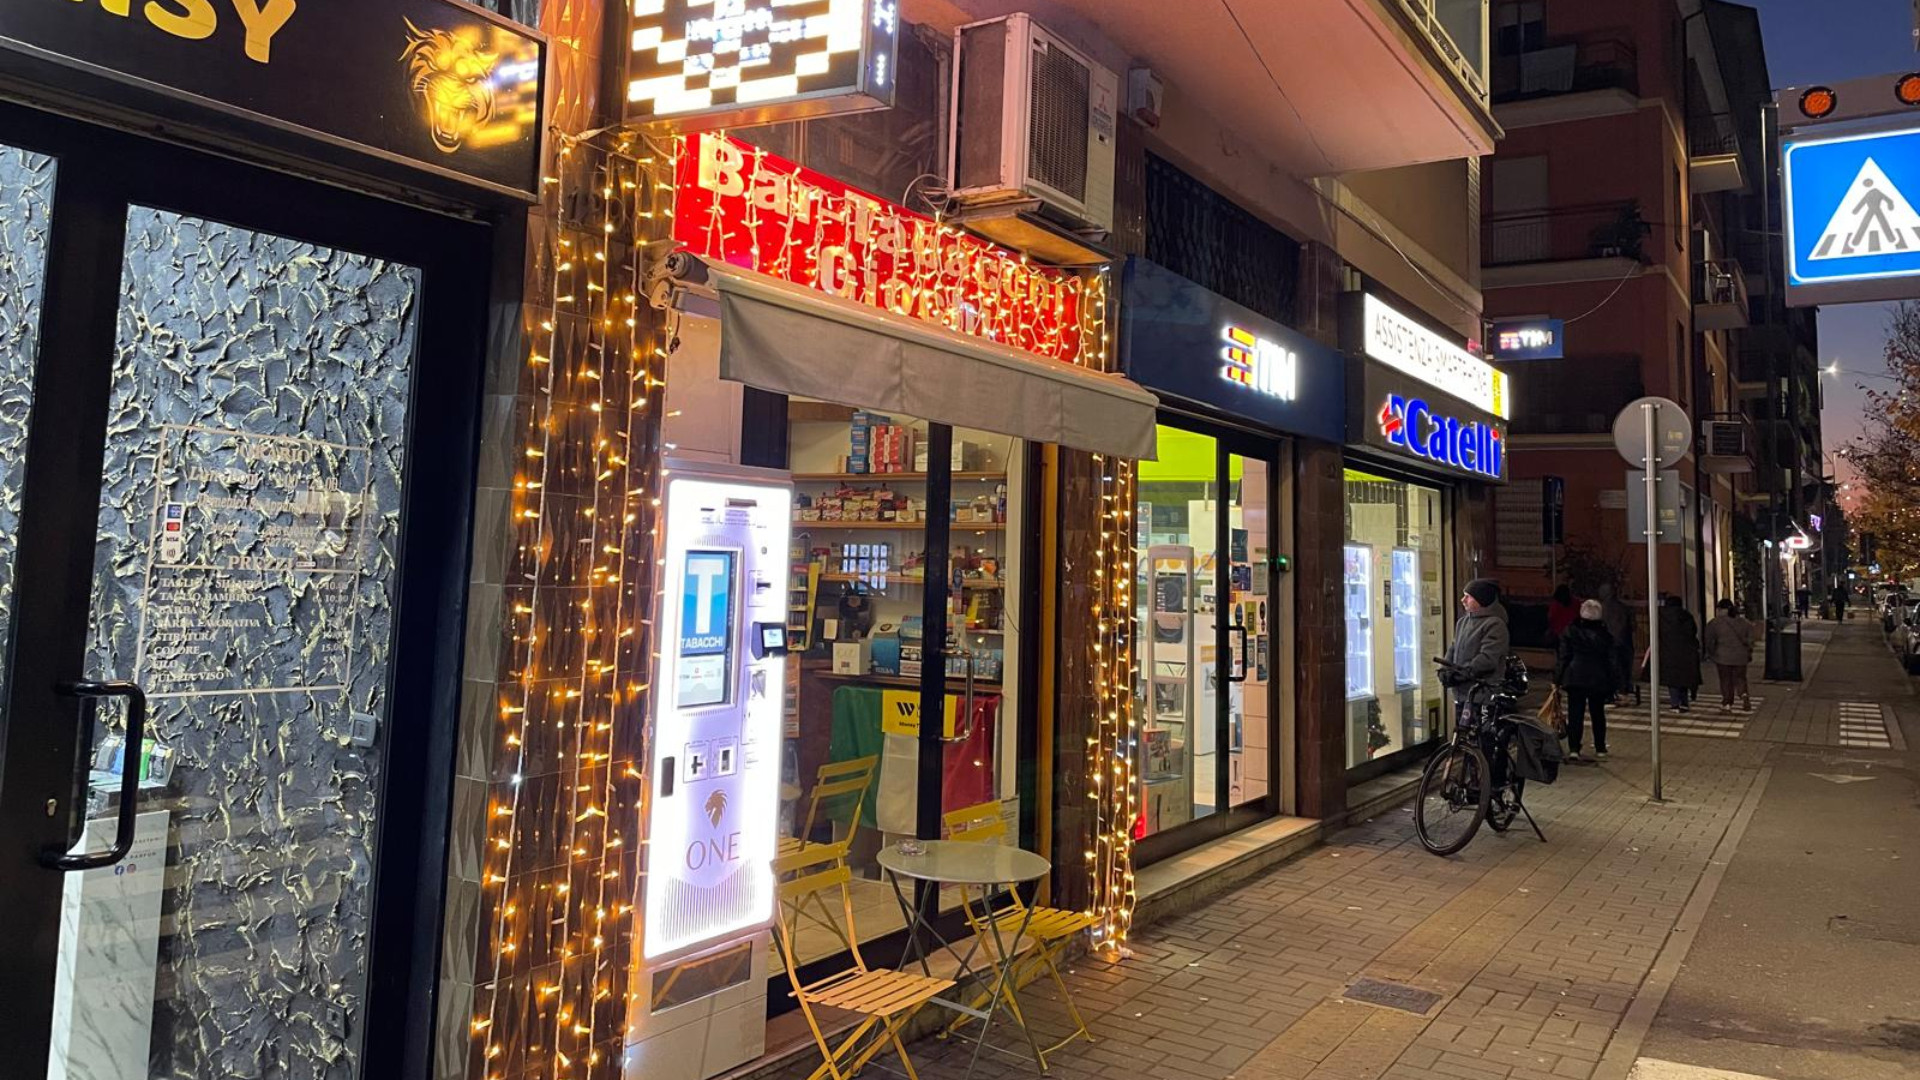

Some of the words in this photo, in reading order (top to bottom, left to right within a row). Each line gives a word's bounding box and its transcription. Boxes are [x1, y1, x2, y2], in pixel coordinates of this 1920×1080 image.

[1404, 398, 1500, 478] Catelli
[228, 555, 295, 570] PREZZI
[680, 634, 724, 649] TABACCHI
[199, 671, 225, 681] VISO
[686, 831, 742, 870] ONE
